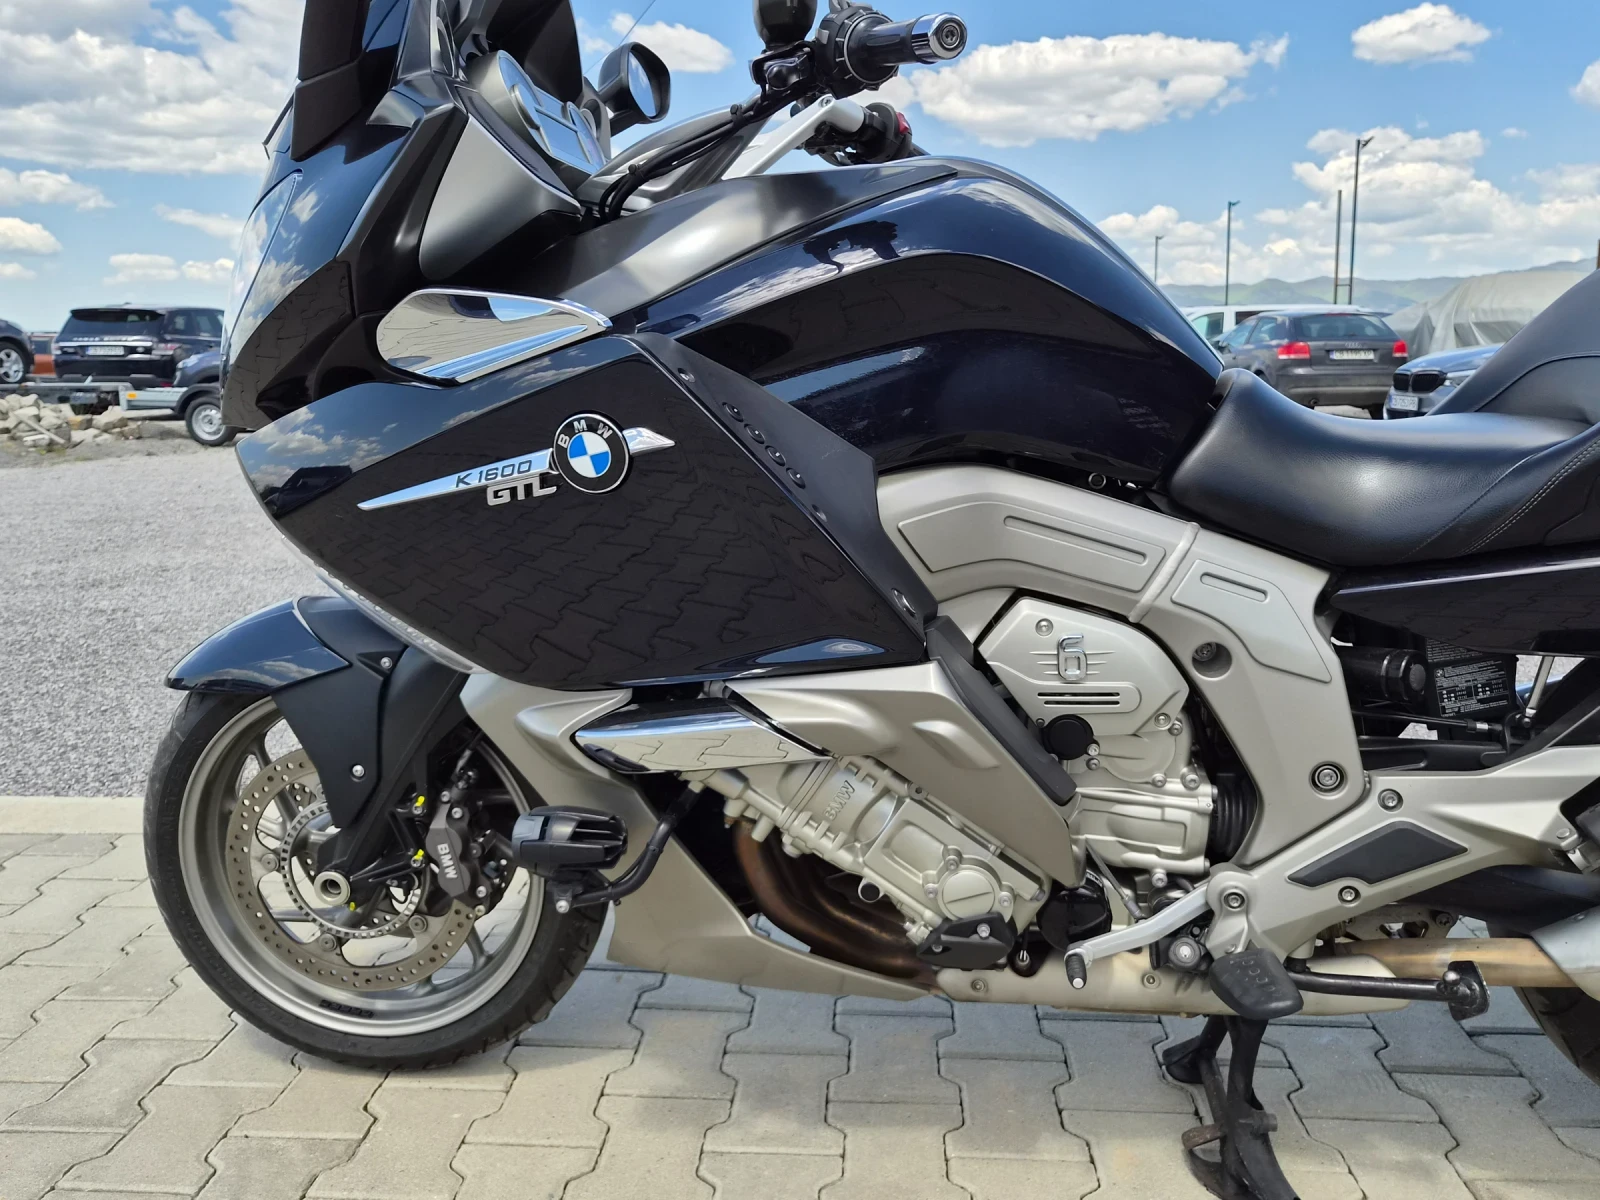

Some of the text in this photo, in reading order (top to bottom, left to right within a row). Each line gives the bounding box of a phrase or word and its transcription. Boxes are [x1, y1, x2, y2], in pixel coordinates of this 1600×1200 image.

[557, 419, 613, 448] BMW
[456, 460, 533, 488] K 1600
[486, 475, 557, 506] GTL
[824, 779, 855, 821] BMW
[437, 842, 459, 879] BMW
